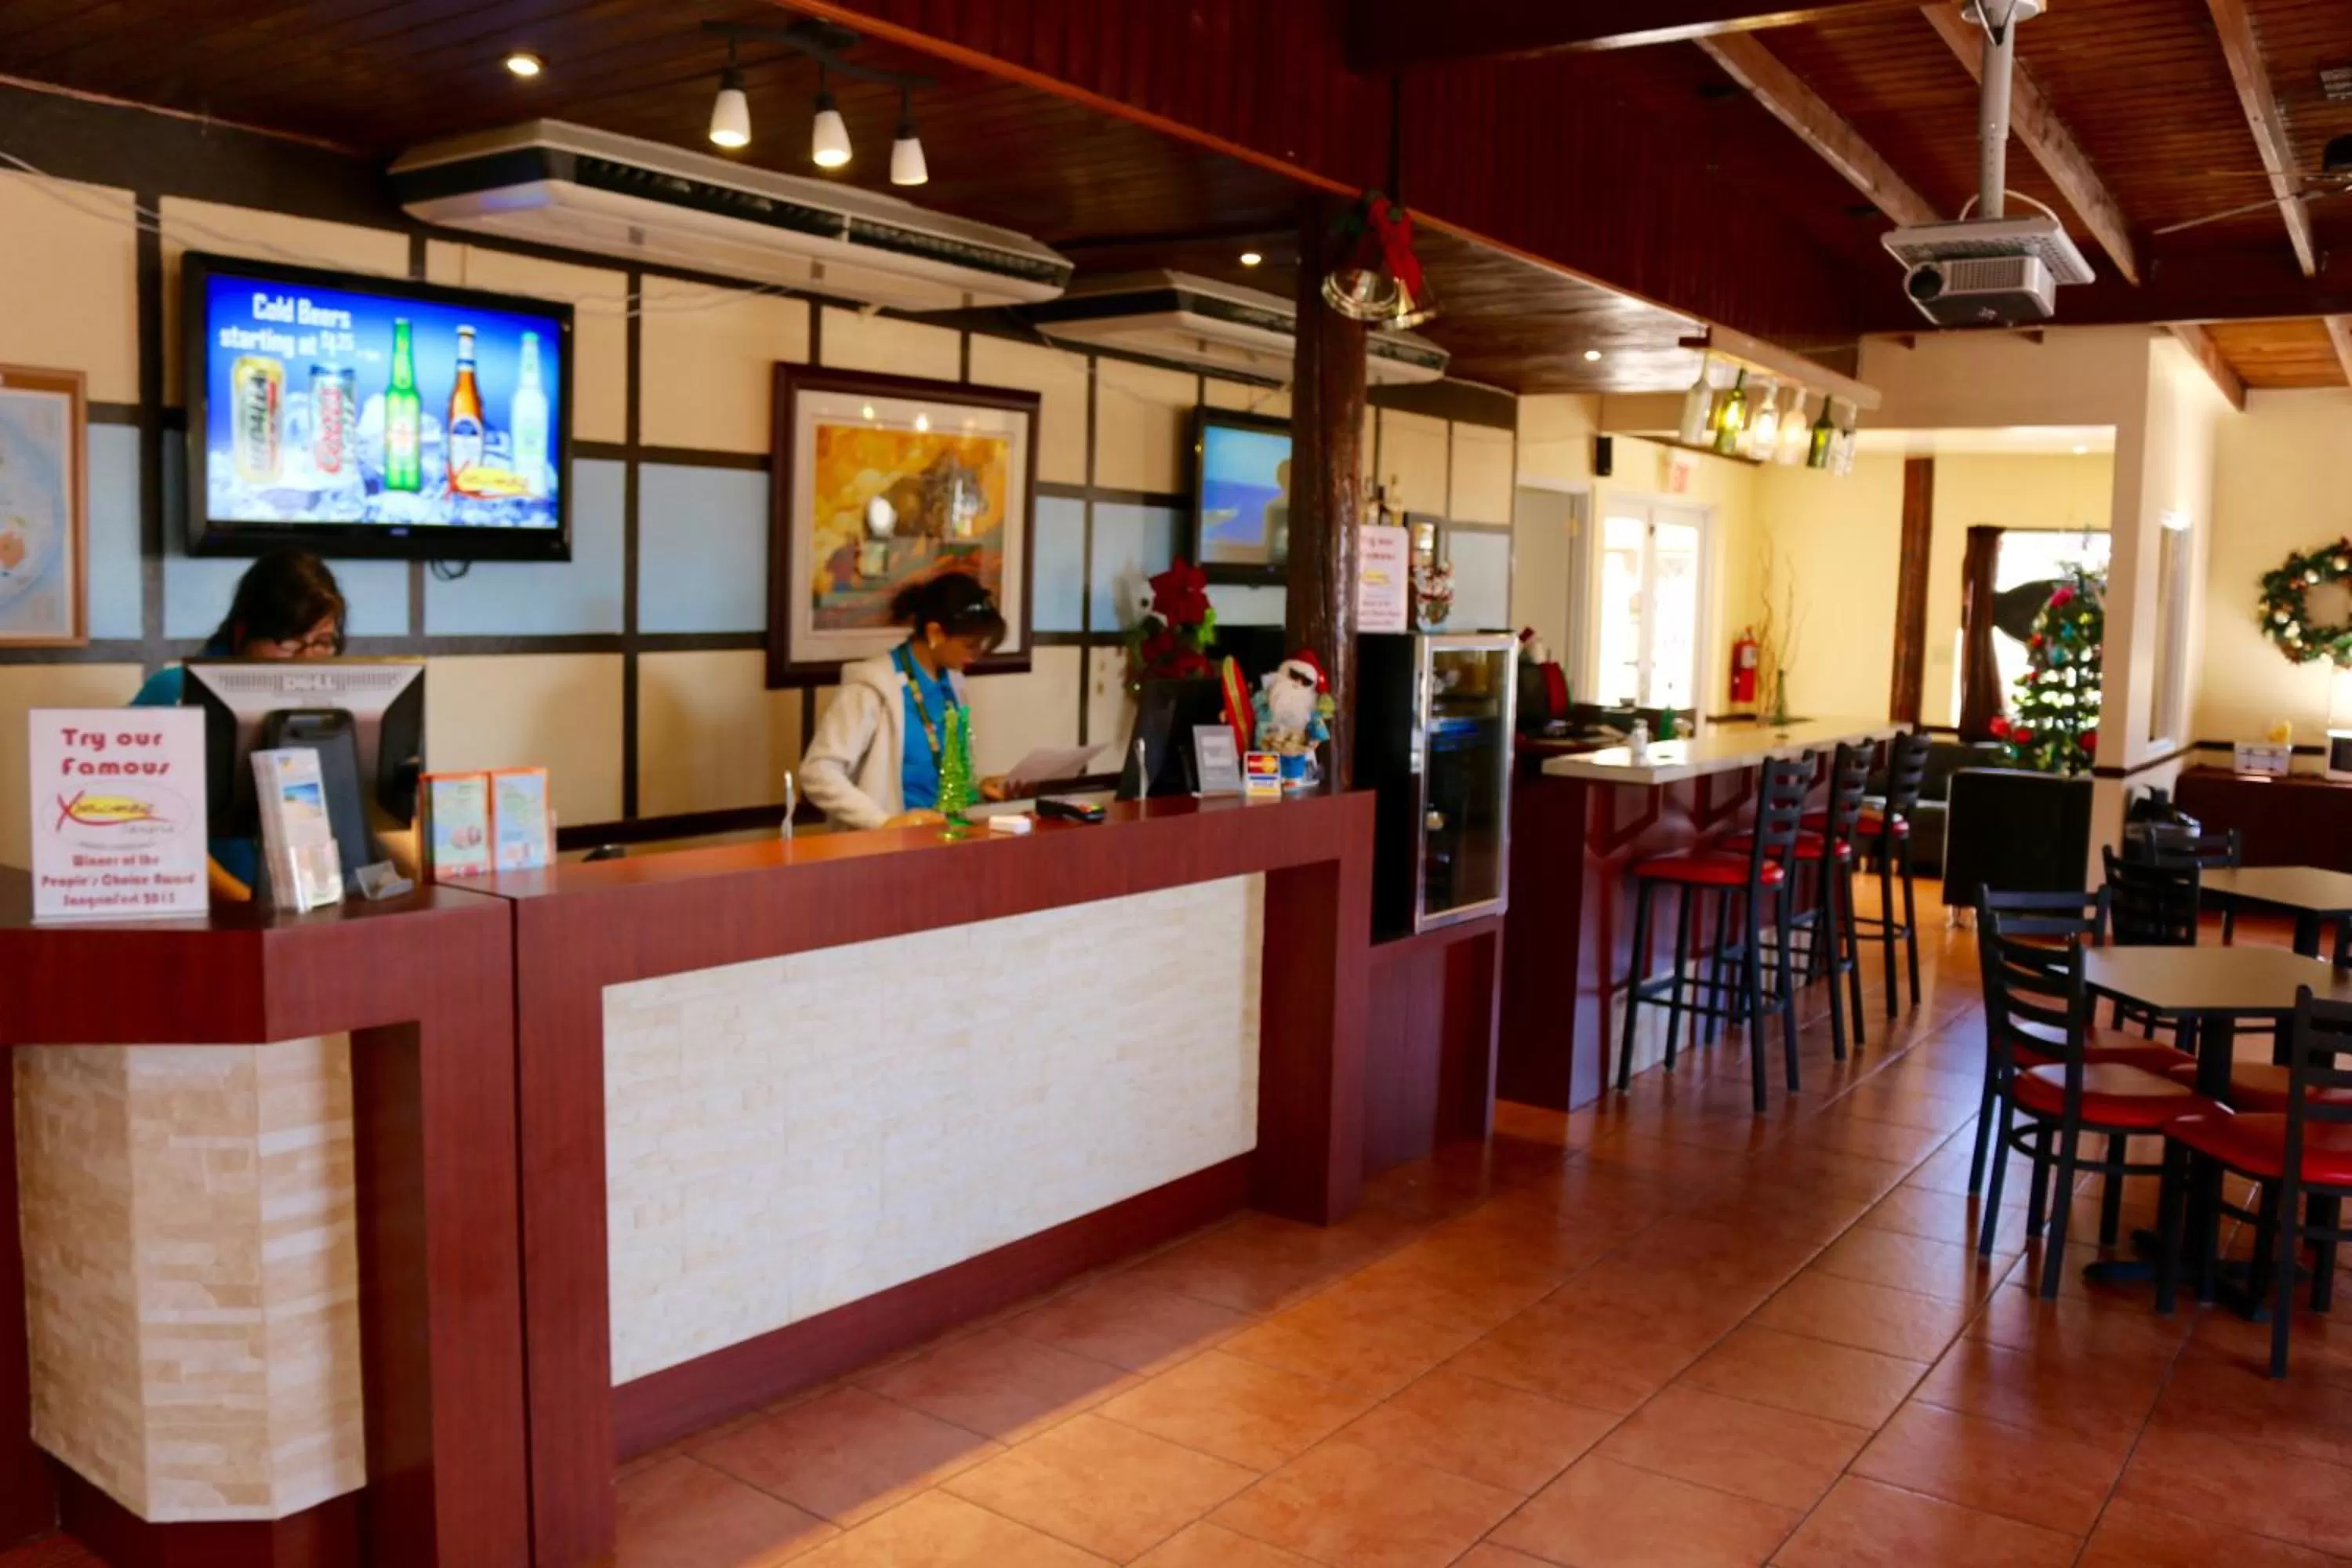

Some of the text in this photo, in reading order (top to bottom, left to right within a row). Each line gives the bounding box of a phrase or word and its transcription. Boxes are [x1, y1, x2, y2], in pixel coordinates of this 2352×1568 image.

[252, 292, 352, 329] Cold Beers
[220, 326, 295, 359] starting
[298, 334, 318, 356] at
[61, 728, 164, 752] Try our
[61, 757, 171, 775] Famous
[101, 873, 148, 885] Choice
